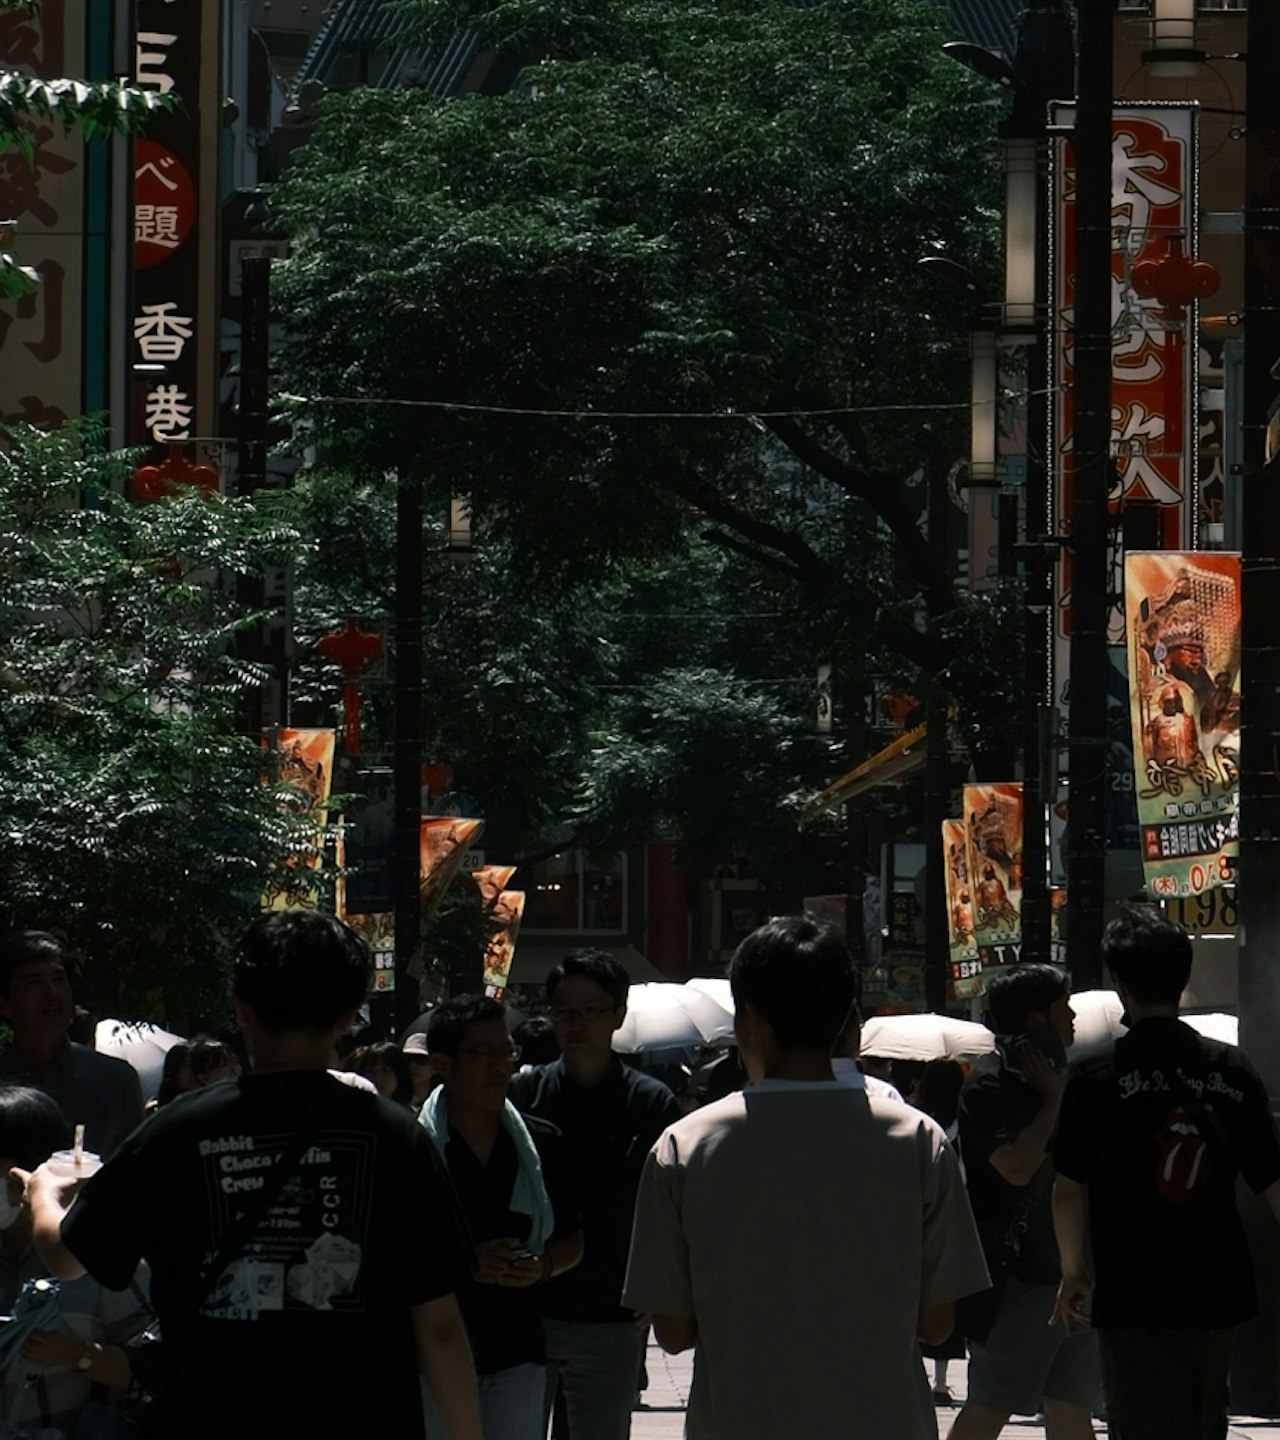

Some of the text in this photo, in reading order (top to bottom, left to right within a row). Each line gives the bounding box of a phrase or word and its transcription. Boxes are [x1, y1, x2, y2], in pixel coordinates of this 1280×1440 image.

[199, 1134, 256, 1156] Rabbit
[220, 1175, 265, 1194] Crew
[319, 1176, 341, 1227] CCR
